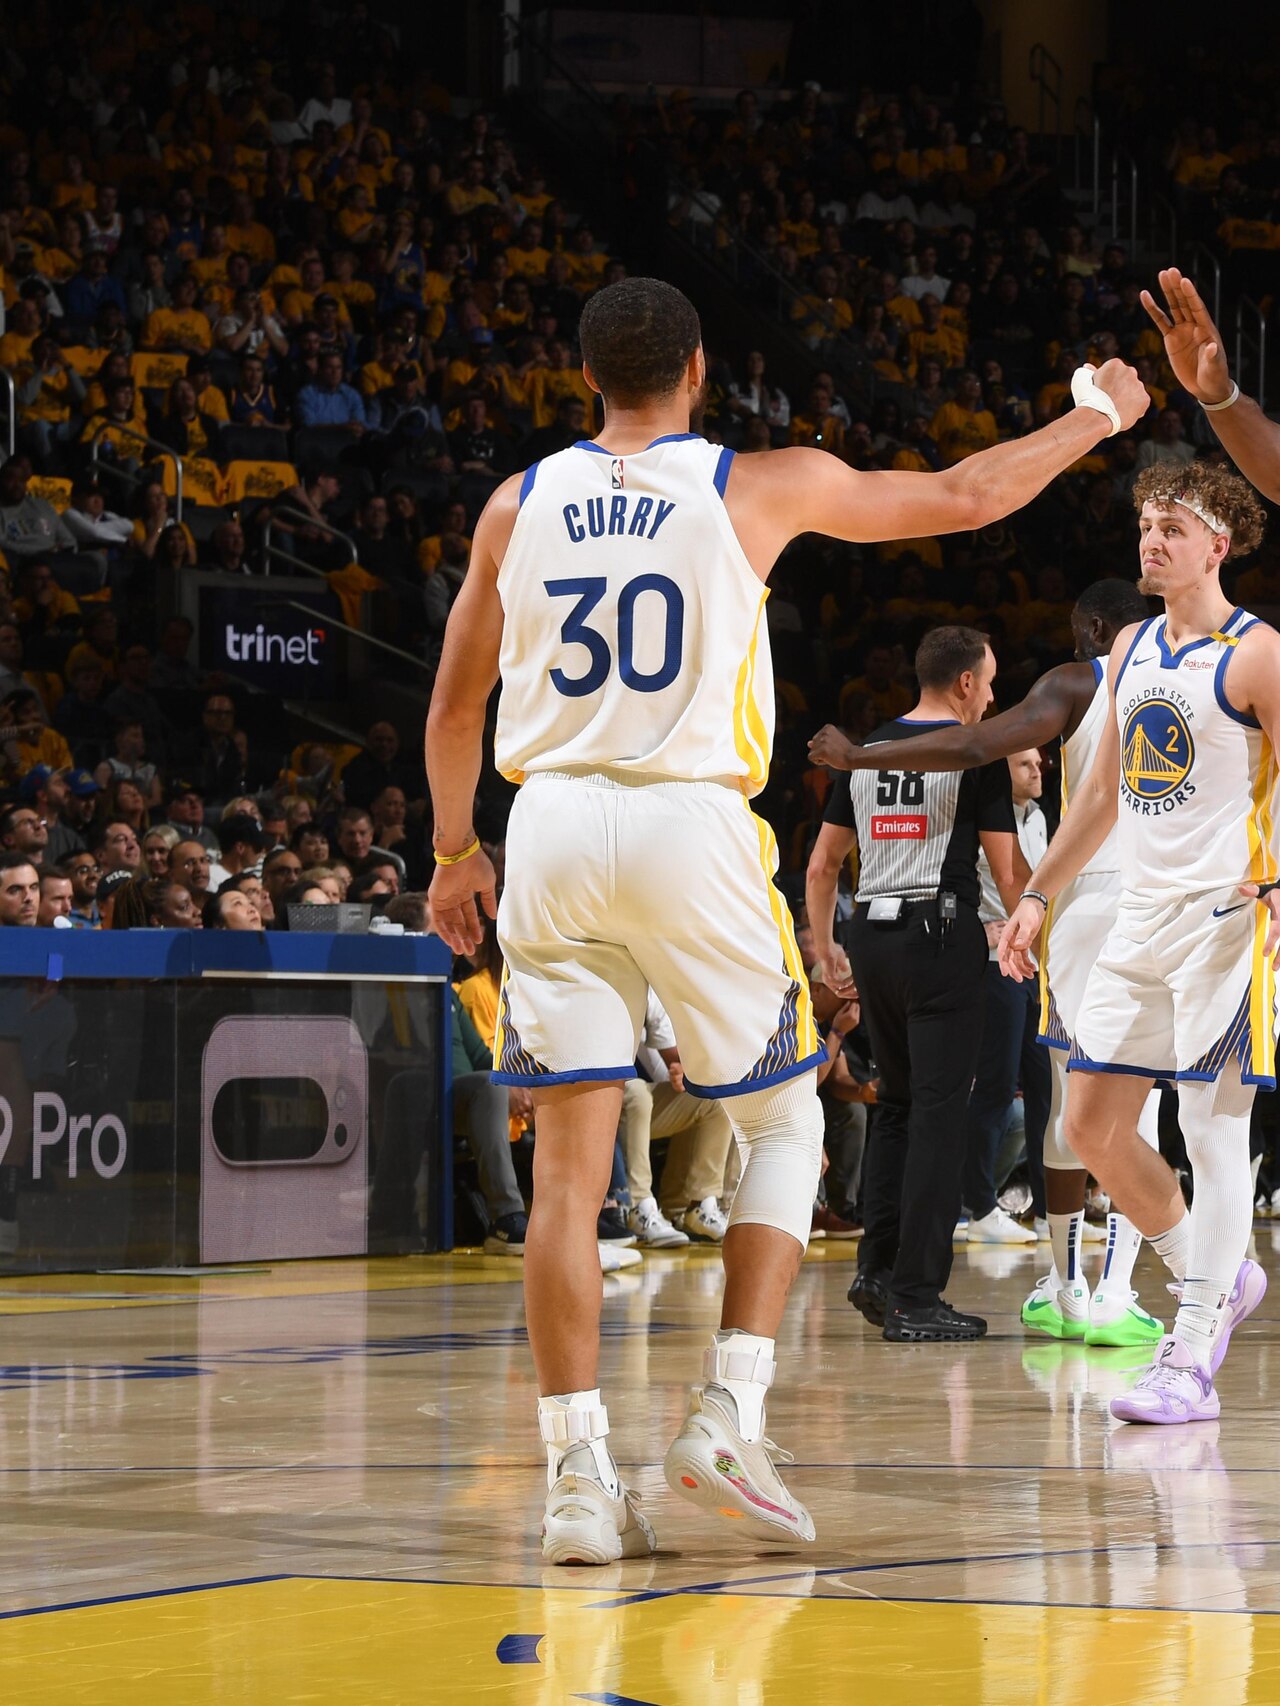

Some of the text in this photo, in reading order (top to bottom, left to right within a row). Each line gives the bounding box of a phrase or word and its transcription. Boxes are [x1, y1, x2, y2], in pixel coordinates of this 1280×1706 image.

[563, 495, 675, 543] CURRY
[225, 623, 320, 666] trinet
[543, 573, 684, 697] 30
[1184, 659, 1214, 670] Rakuten
[1123, 687, 1194, 722] GOLDEN STATE
[1166, 726, 1179, 752] 2
[877, 769, 924, 806] 58
[1121, 777, 1196, 815] WARRIORS
[876, 821, 920, 833] Emirates
[32, 1091, 127, 1179] Pro
